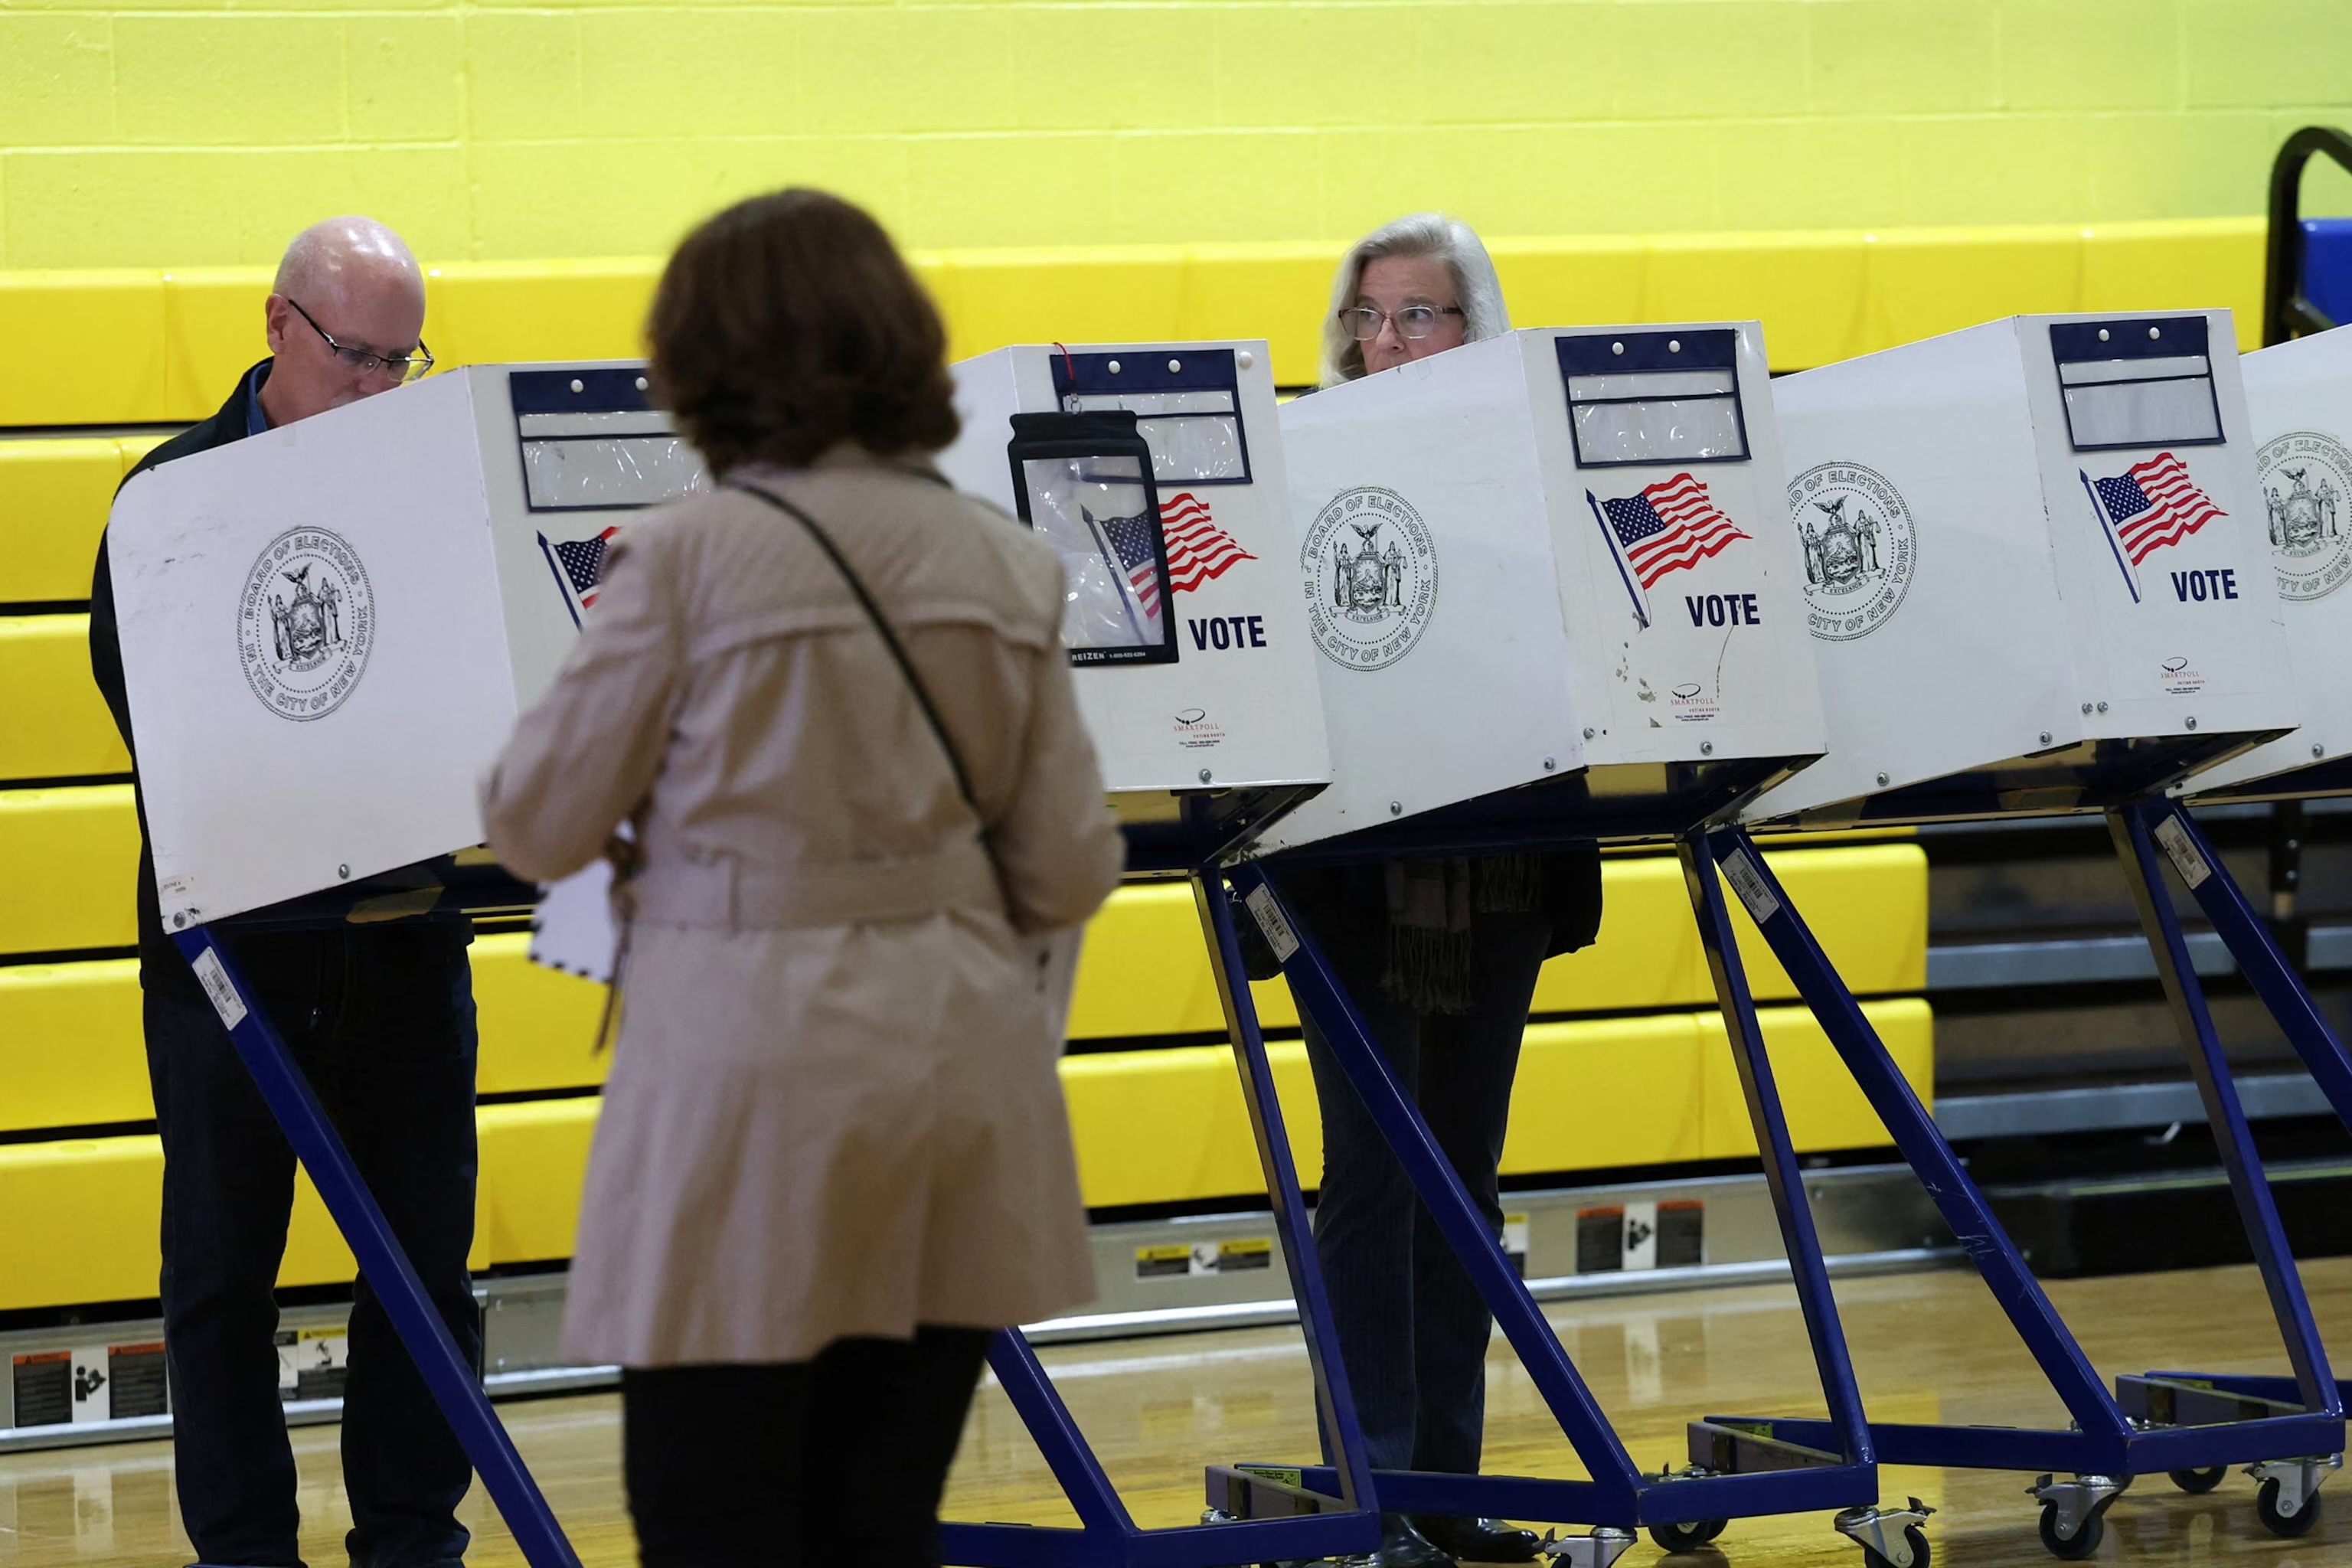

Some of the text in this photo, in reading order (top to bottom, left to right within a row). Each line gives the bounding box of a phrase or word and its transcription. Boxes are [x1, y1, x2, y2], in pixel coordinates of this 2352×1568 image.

[2272, 442, 2290, 458] OF
[2295, 439, 2352, 489] ELECTION
[1804, 474, 1823, 492] OF
[1828, 470, 1901, 519] ELECTIONS
[1307, 495, 1429, 560] BOARD OF ELECTIONS
[244, 535, 361, 620] BOARD OF ELECTIONS
[1807, 537, 1909, 632] CITY OF NEW YORK
[2170, 569, 2239, 602] VOTE
[2302, 577, 2320, 593] OF
[2323, 553, 2351, 584] NEW
[1187, 616, 1267, 651] VOTE
[1304, 578, 1432, 662] IN THE CITY OF NEW YORK
[1684, 593, 1761, 628] VOTE
[244, 605, 368, 712] IN THE CITY OF NEW YORK
[1072, 652, 1105, 661] REIZEN
[1174, 724, 1220, 732] SMARTPOLL
